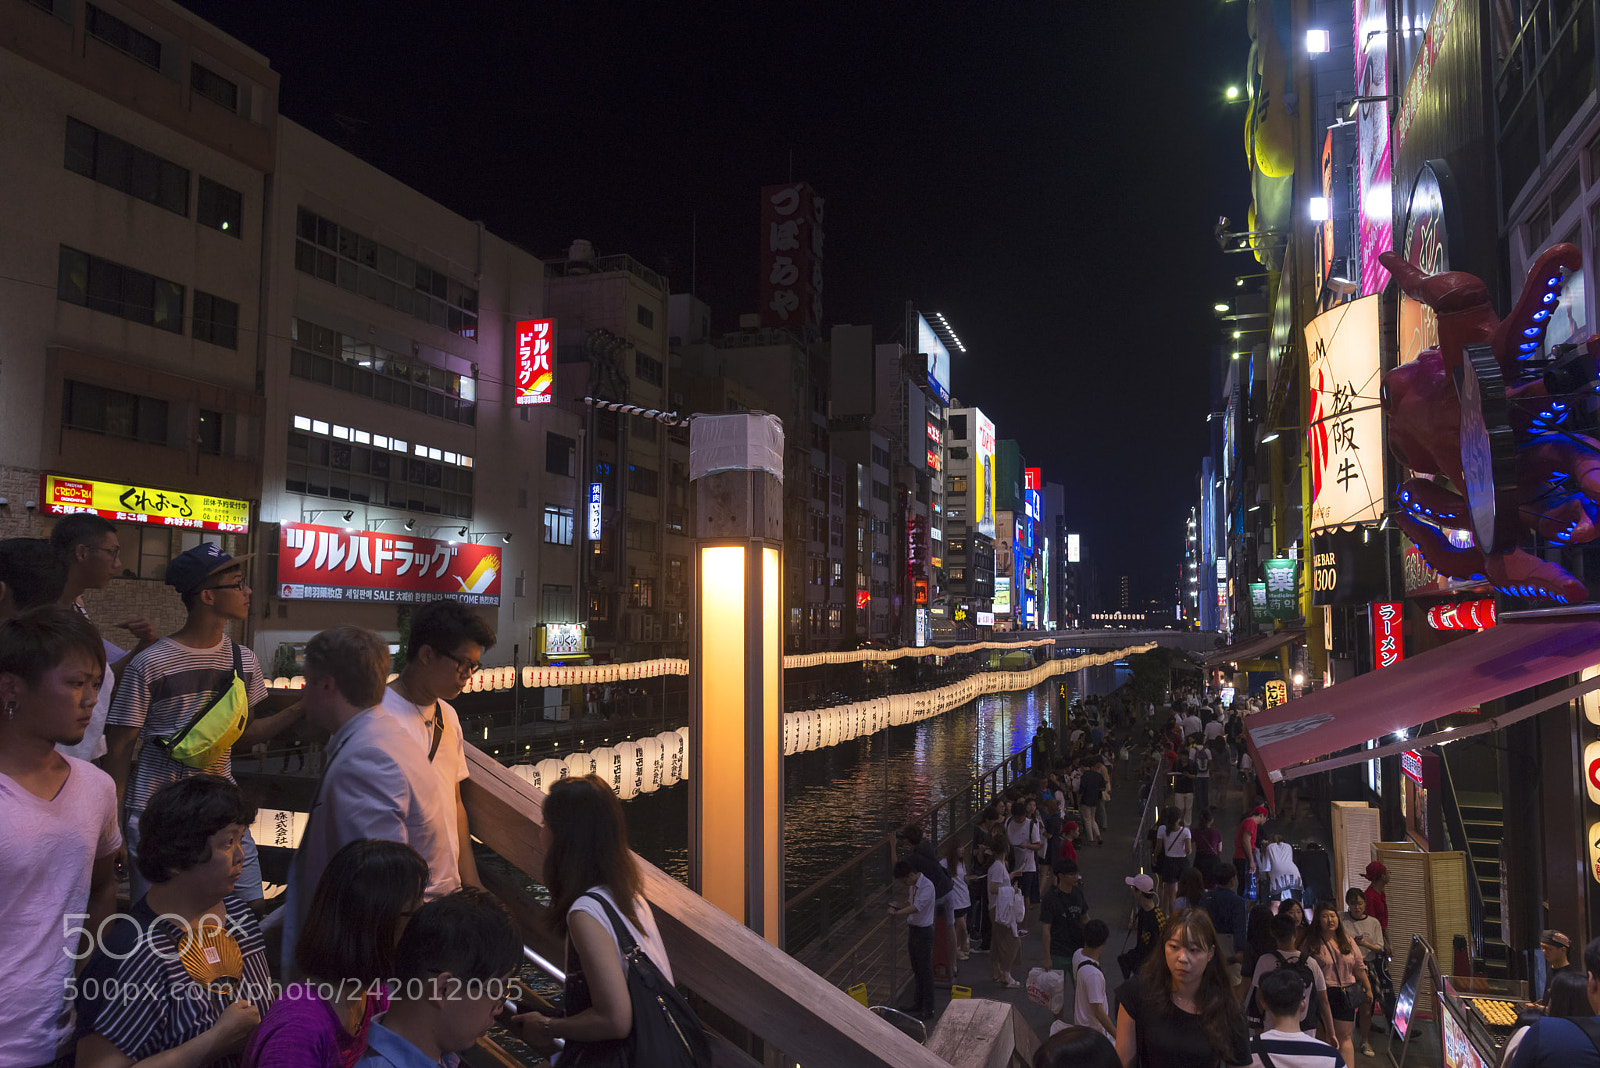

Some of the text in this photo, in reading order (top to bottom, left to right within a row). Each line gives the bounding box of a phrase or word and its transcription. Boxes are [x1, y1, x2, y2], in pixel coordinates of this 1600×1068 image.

[519, 333, 532, 384] ドラッグ
[533, 322, 549, 370] ツルハ
[1331, 380, 1360, 493] 松阪牛
[120, 487, 193, 517] くれおーる
[592, 485, 600, 502] 焼肉
[116, 511, 148, 523] たこ焼
[164, 517, 203, 528] お好み焼
[218, 522, 244, 531] 串かつ
[286, 528, 458, 578] ツルハドラッグ
[1321, 552, 1336, 566] BAR
[373, 590, 395, 601] SALE
[1267, 568, 1295, 592] 薬
[1379, 604, 1399, 667] ラーメン
[274, 811, 289, 845] 株式会社
